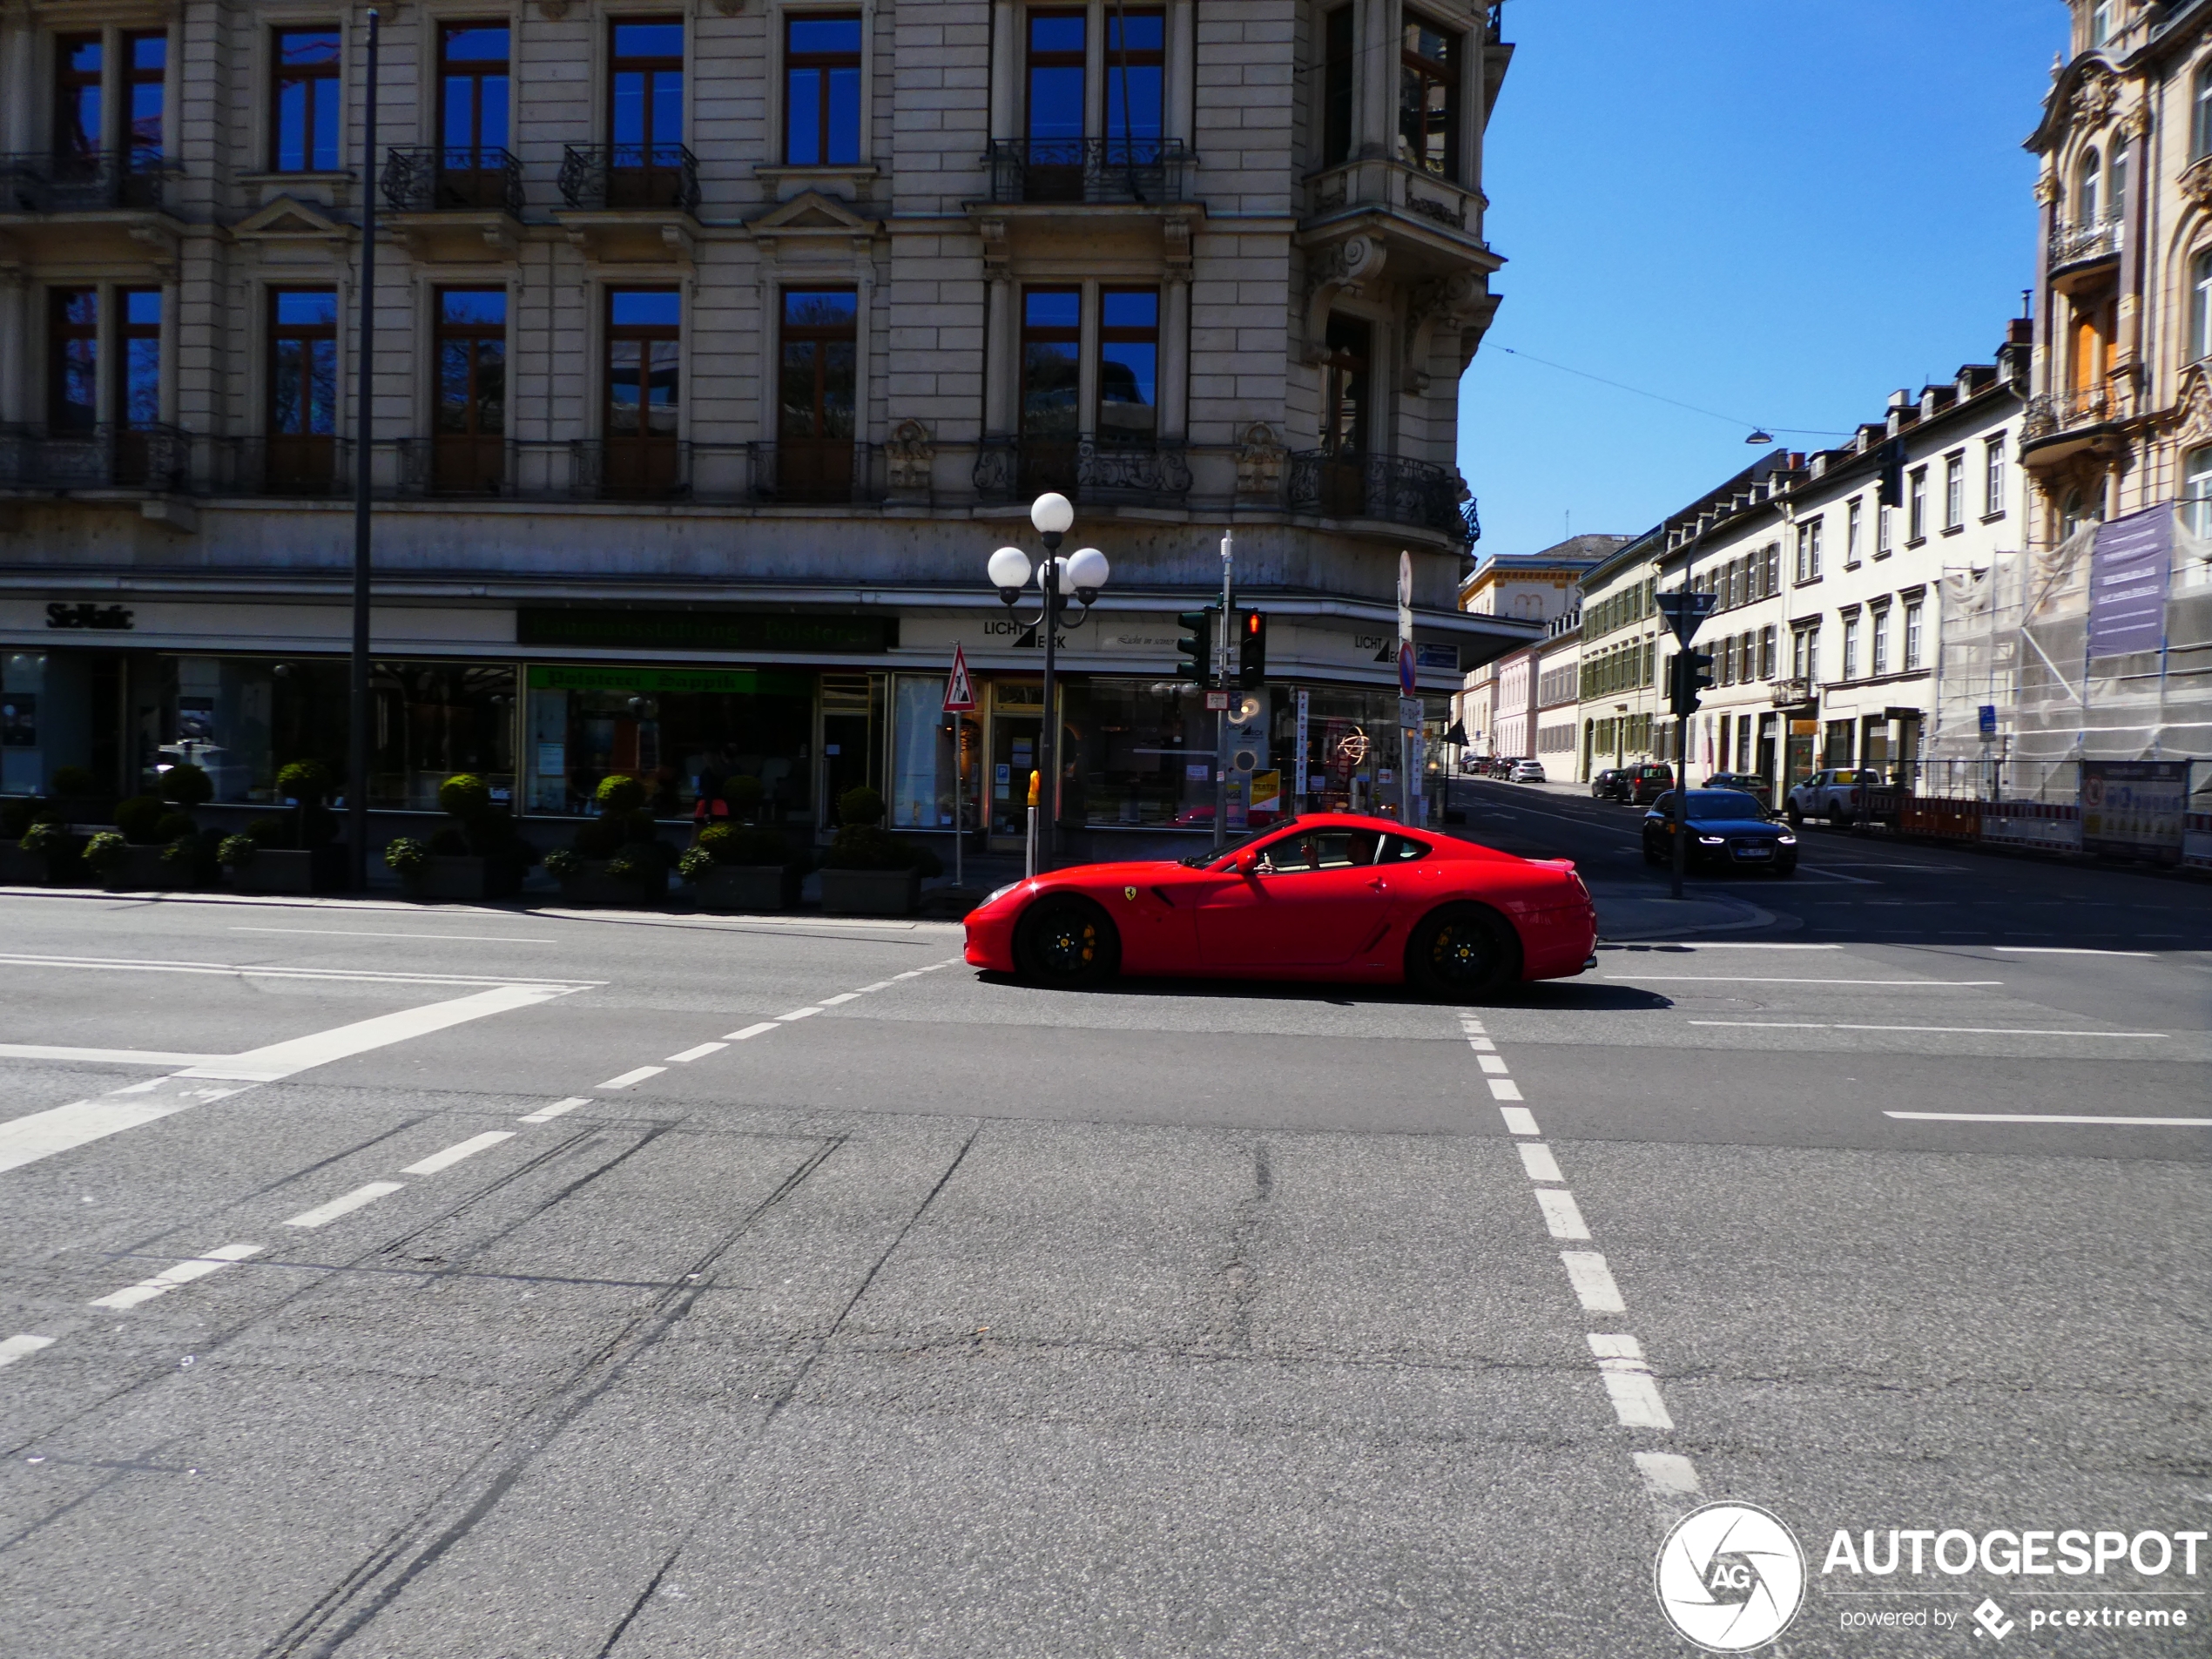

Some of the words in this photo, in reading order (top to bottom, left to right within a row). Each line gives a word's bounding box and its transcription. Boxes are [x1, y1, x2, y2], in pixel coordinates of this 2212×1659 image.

[764, 621, 867, 642] Polsterei
[1355, 635, 1382, 651] LICHT
[548, 671, 642, 687] Polsterei
[999, 767, 1007, 776] P
